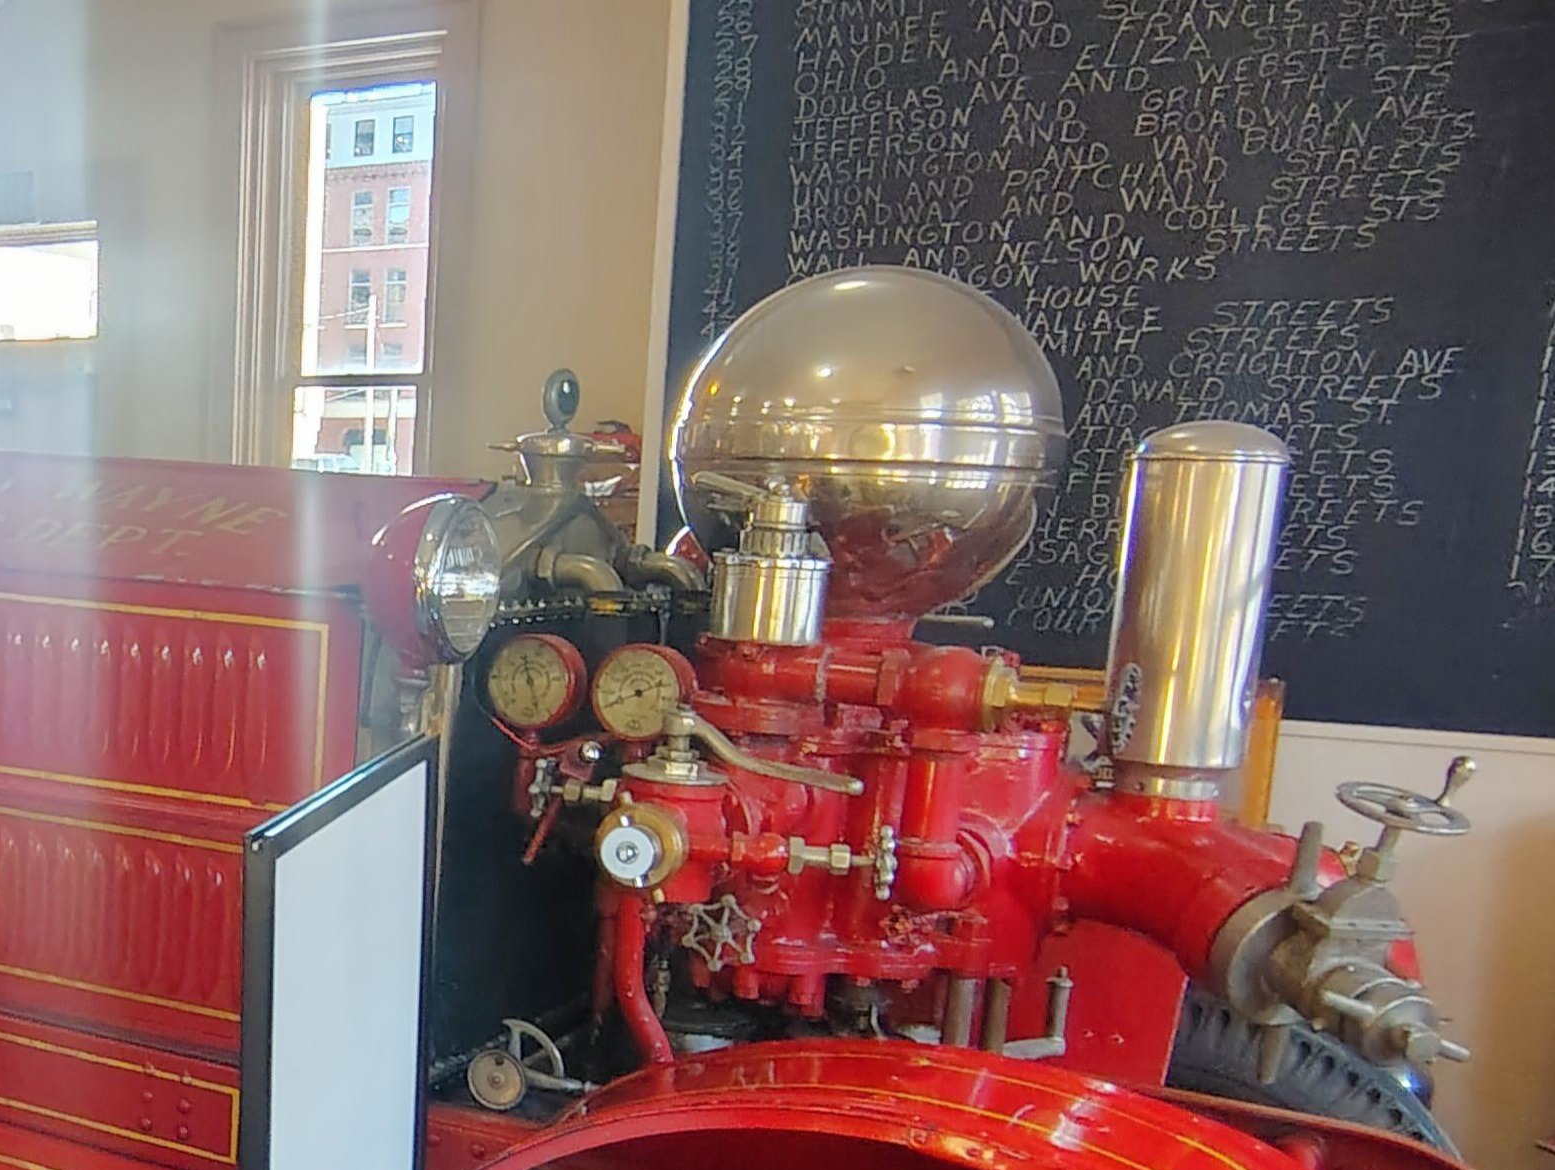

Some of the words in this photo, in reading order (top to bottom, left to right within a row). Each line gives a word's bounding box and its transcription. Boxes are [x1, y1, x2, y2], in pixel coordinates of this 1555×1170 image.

[794, 11, 946, 51] MAUMEE
[976, 2, 1054, 33] AND
[797, 36, 951, 73] HAYDEN
[989, 23, 1072, 54] AND
[794, 66, 886, 96] OHIO
[939, 53, 1020, 84] AND
[1076, 32, 1210, 70] ELIZA
[1251, 8, 1452, 52] STREETS
[798, 86, 943, 119] DOUGLAS
[969, 77, 1032, 105] AVE
[1060, 67, 1149, 96] AND
[1197, 42, 1388, 84] WEBSTER
[791, 131, 970, 162] JEFFERSON
[1002, 120, 1087, 147] AND
[1134, 98, 1353, 137] BROADWAY
[793, 106, 973, 142] JEFFERSON
[1000, 100, 1077, 125] AND
[788, 149, 1013, 187] WASHINGTON
[1042, 142, 1110, 169] AND
[1153, 132, 1220, 162] VAN
[1243, 120, 1372, 155] BUREN
[793, 182, 882, 208] UNION
[905, 176, 974, 207] AND
[1000, 157, 1228, 196] PRITCHARD
[1282, 142, 1463, 176] STREETS
[793, 198, 968, 229] BROADWAY
[1001, 191, 1074, 220] AND
[1119, 182, 1225, 212] WALL
[1266, 168, 1445, 202] STREETS
[788, 251, 872, 273] WALL
[903, 246, 971, 268] AND
[996, 236, 1145, 264] NELSON
[1204, 222, 1378, 255] STREETS
[790, 218, 1014, 253] WASHINGTON
[1044, 213, 1125, 241] AND
[1165, 200, 1329, 231] COLLEGE
[1079, 255, 1217, 283] WORKS
[1026, 284, 1144, 311] HOUSE
[1210, 297, 1394, 327] STREETS
[1185, 323, 1361, 353] STREETS
[1076, 354, 1144, 379] AND
[1168, 349, 1376, 378] CREIGHTON
[1396, 347, 1464, 376] AVE
[1087, 377, 1225, 403] DEWALD
[1262, 373, 1444, 401] STREETS
[1076, 403, 1139, 427] AND
[1173, 400, 1317, 425] THOMAS
